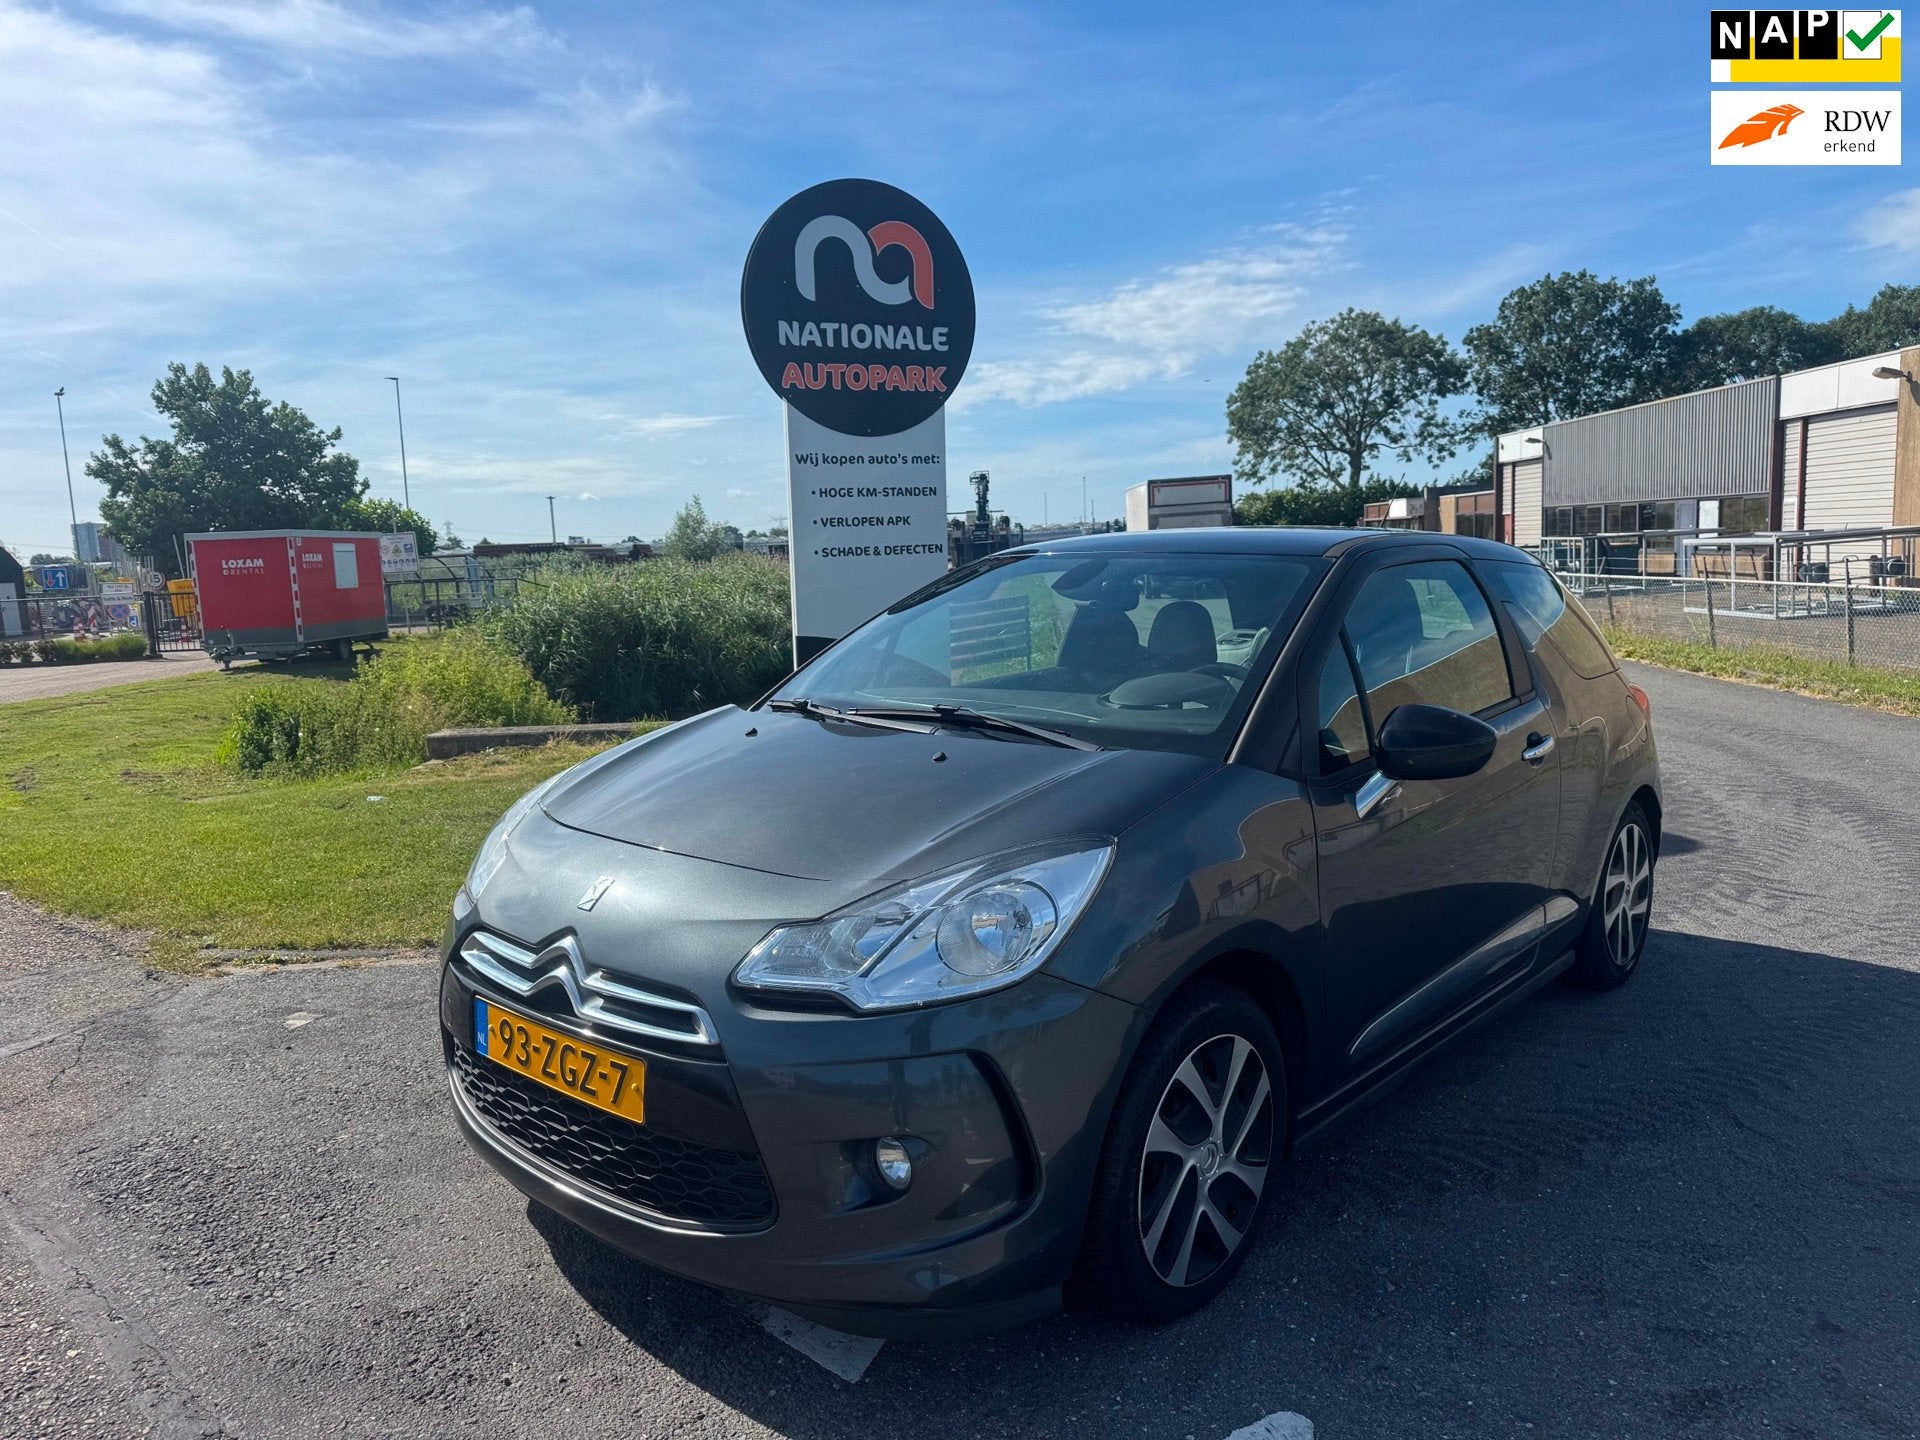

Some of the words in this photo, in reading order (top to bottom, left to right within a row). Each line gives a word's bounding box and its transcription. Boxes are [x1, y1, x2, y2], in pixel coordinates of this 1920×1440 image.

[777, 320, 949, 351] NATIONALE
[781, 361, 947, 392] AUTOPARK
[795, 453, 819, 467] Wij
[822, 453, 865, 467] kopen
[868, 453, 908, 465] auto's
[911, 453, 940, 465] met:
[819, 487, 854, 498] HOGE
[857, 486, 937, 498] KM-STANDEN
[820, 517, 884, 528] VERLOPEN
[887, 515, 911, 526] APK
[302, 553, 322, 562] LOXAM
[822, 546, 871, 558] SCHADE
[873, 545, 882, 556] &
[884, 543, 943, 556] DEFECTEN
[221, 558, 264, 569] LOXAM
[477, 1032, 487, 1046] NL
[499, 1018, 628, 1104] 93-ZGZ-7
